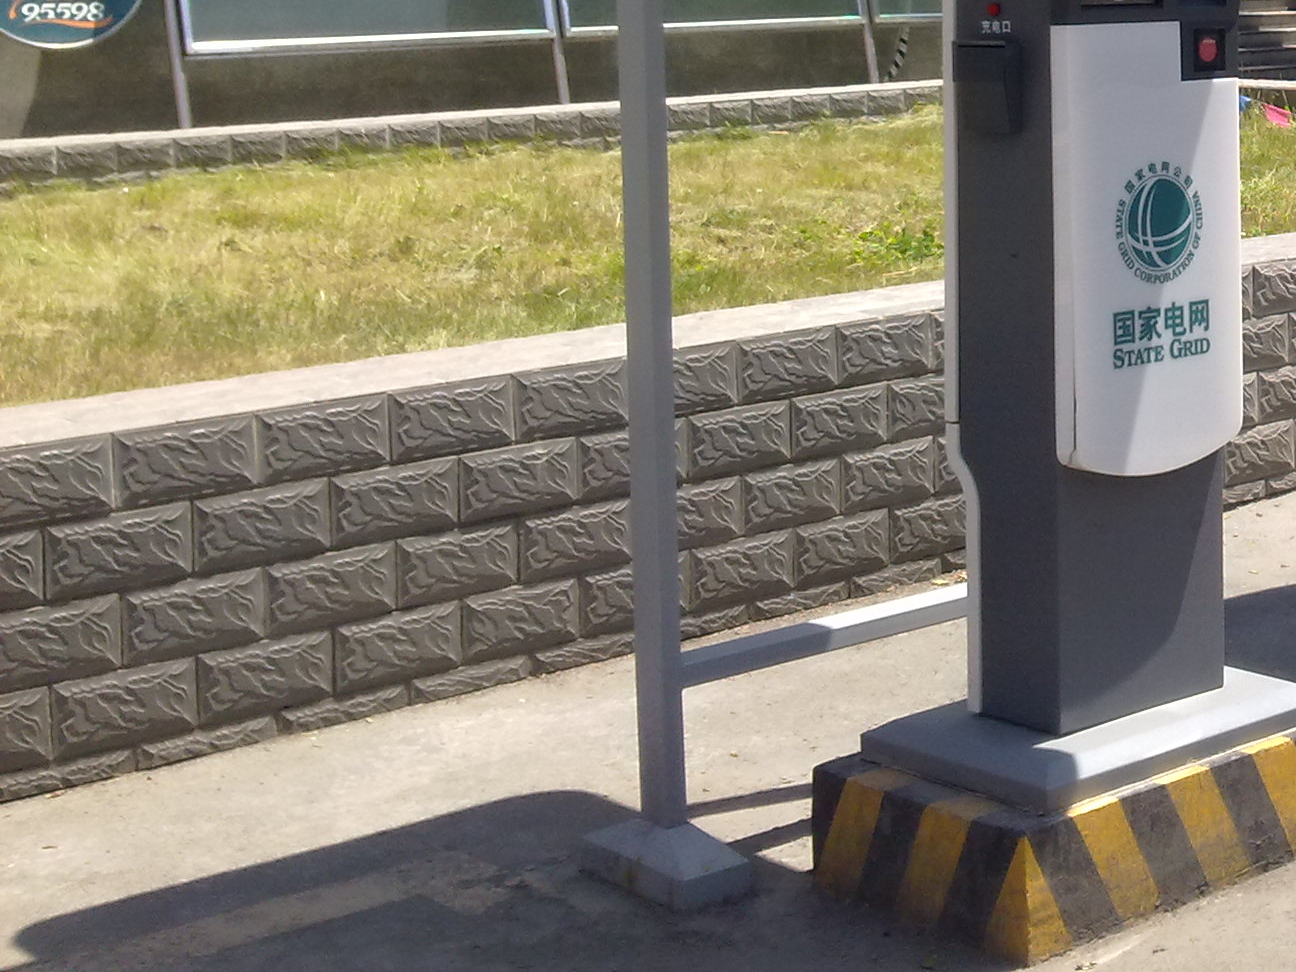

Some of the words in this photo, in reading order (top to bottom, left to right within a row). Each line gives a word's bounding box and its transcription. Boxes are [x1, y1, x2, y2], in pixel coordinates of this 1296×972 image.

[21, 1, 105, 23] 95598
[1124, 161, 1194, 194] 国家电网公司
[1115, 199, 1127, 240] STATE
[1118, 242, 1135, 271] GRID
[1134, 252, 1195, 284] CORPORATION
[1113, 299, 1210, 346] 国家电网
[1113, 345, 1164, 370] STATE
[1170, 337, 1211, 359] GRID
